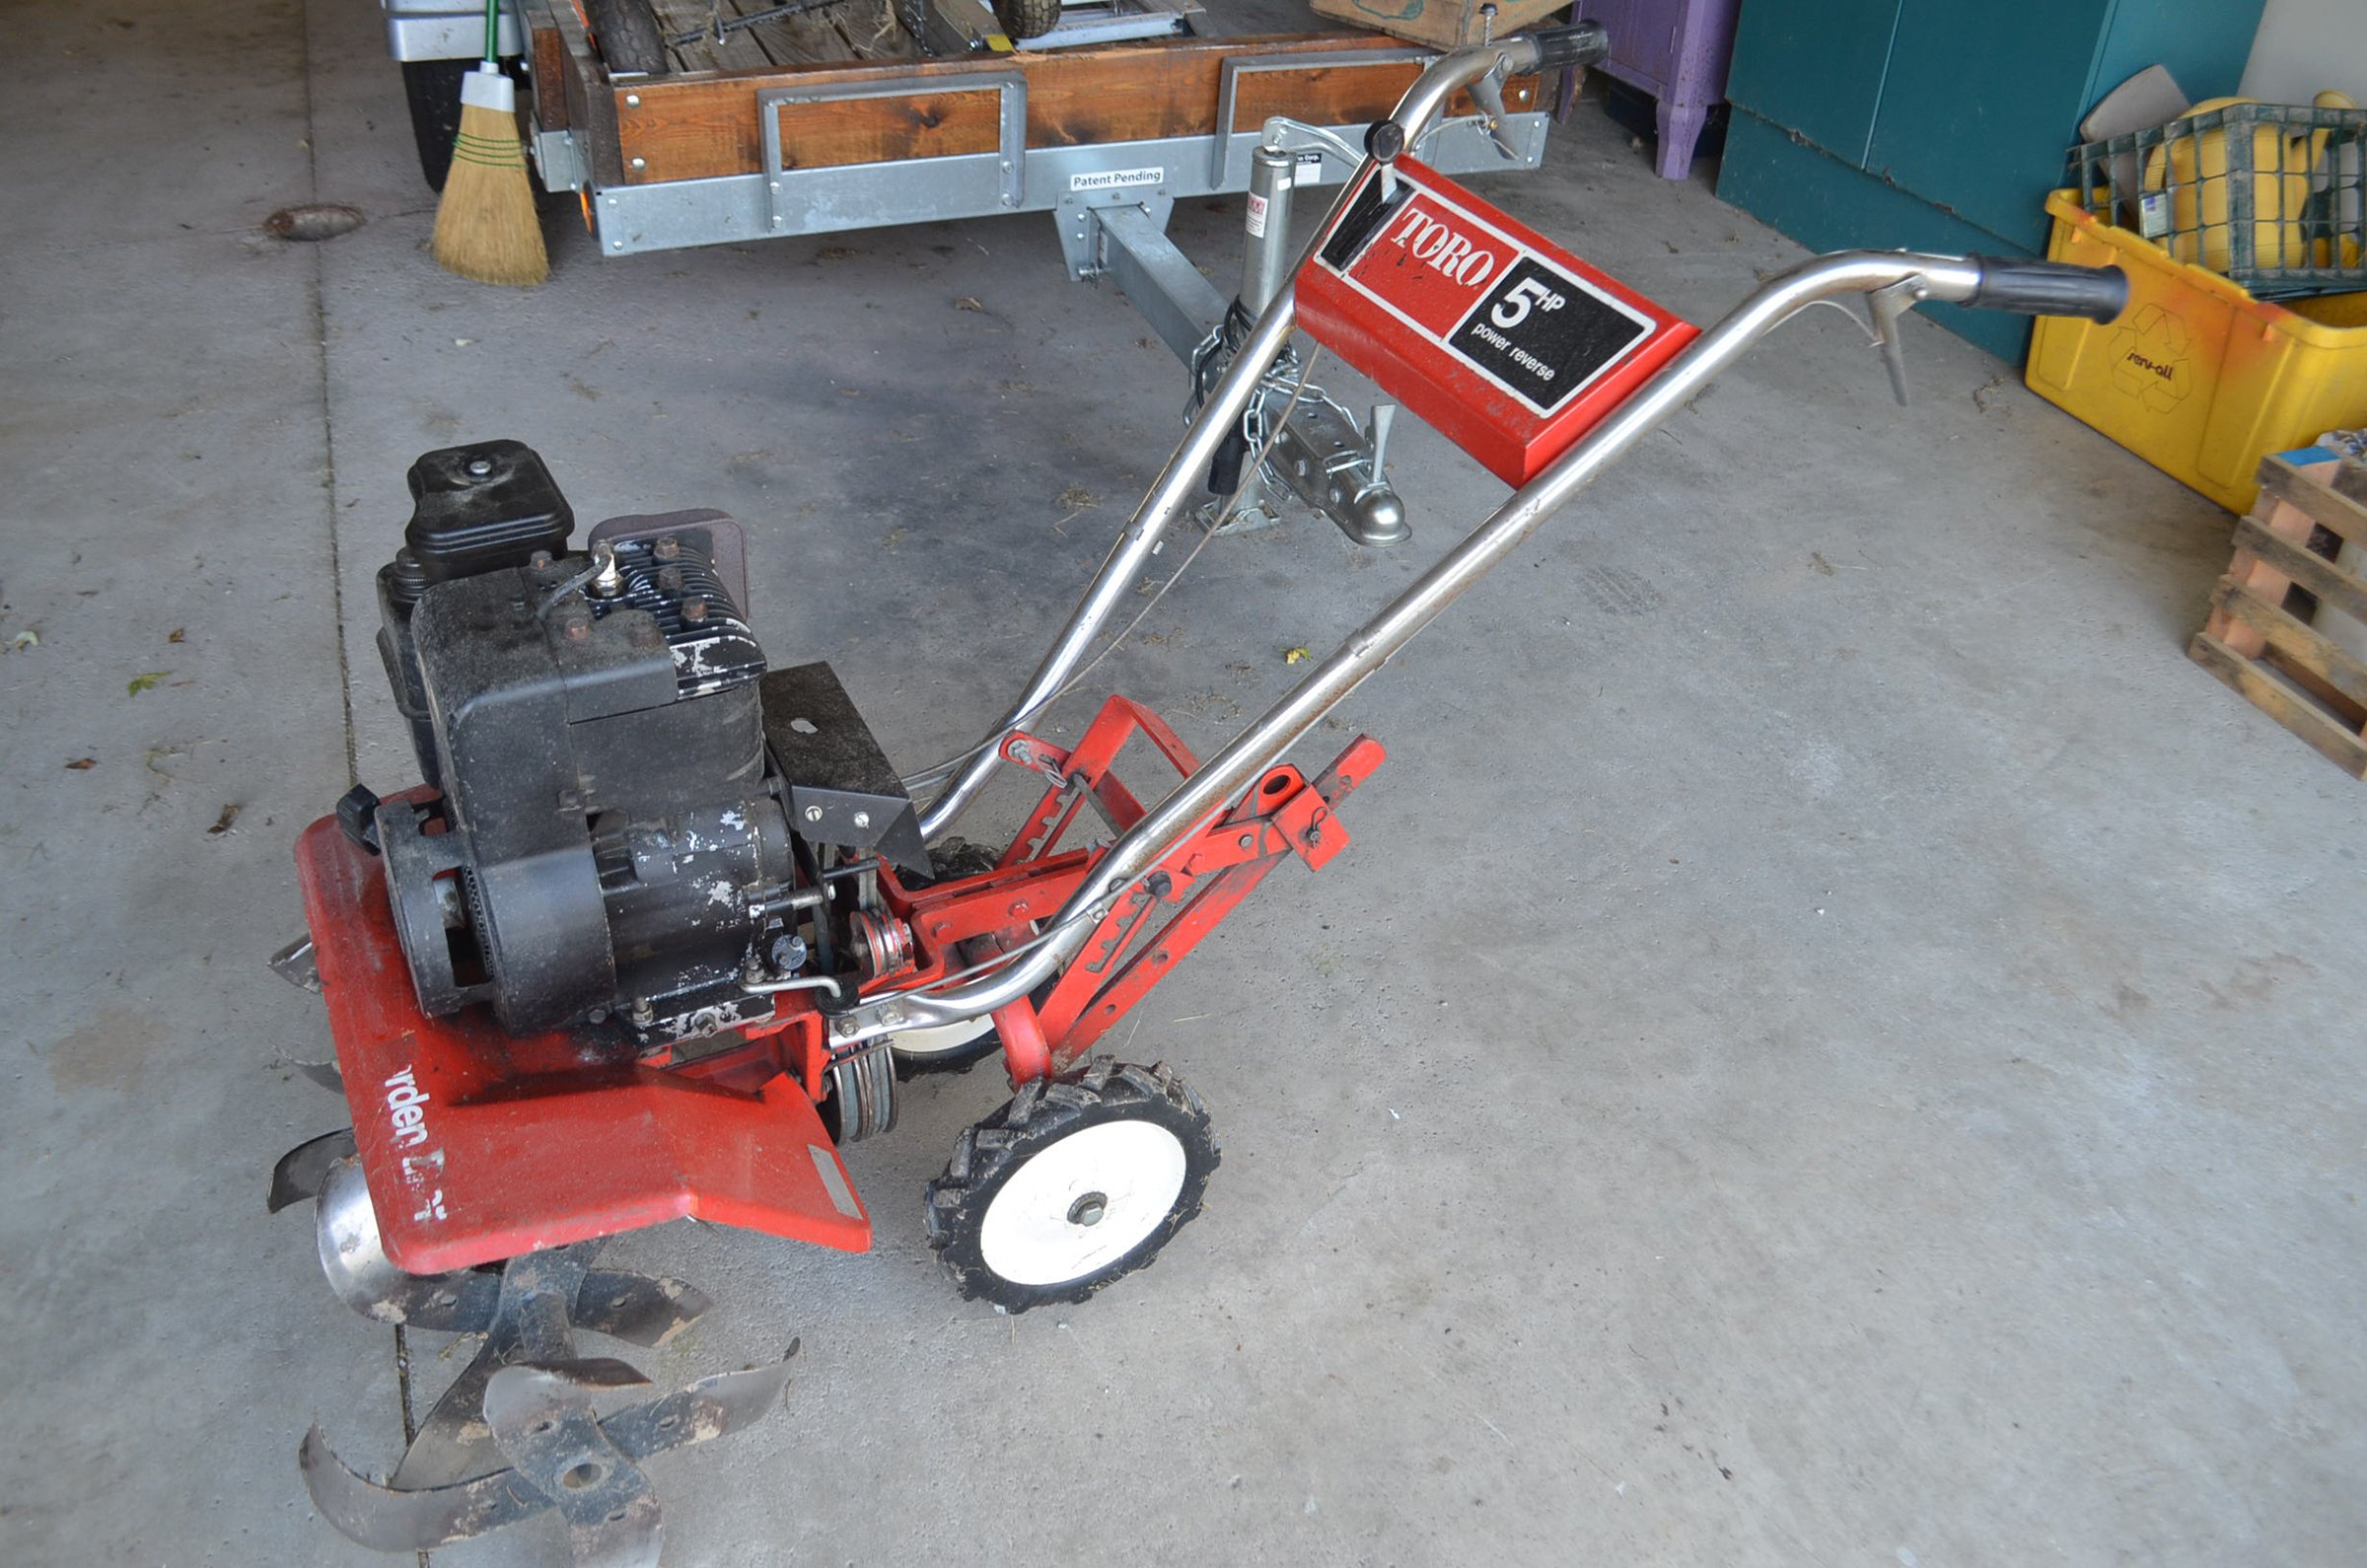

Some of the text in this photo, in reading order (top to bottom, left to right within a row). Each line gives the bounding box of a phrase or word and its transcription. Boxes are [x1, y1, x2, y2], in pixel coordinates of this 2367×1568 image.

[1074, 171, 1161, 186] Patent Pending
[1391, 207, 1494, 287] TORO
[1470, 322, 1555, 381] power reverse
[2126, 352, 2174, 381] serv-all
[385, 1064, 431, 1148] rden
